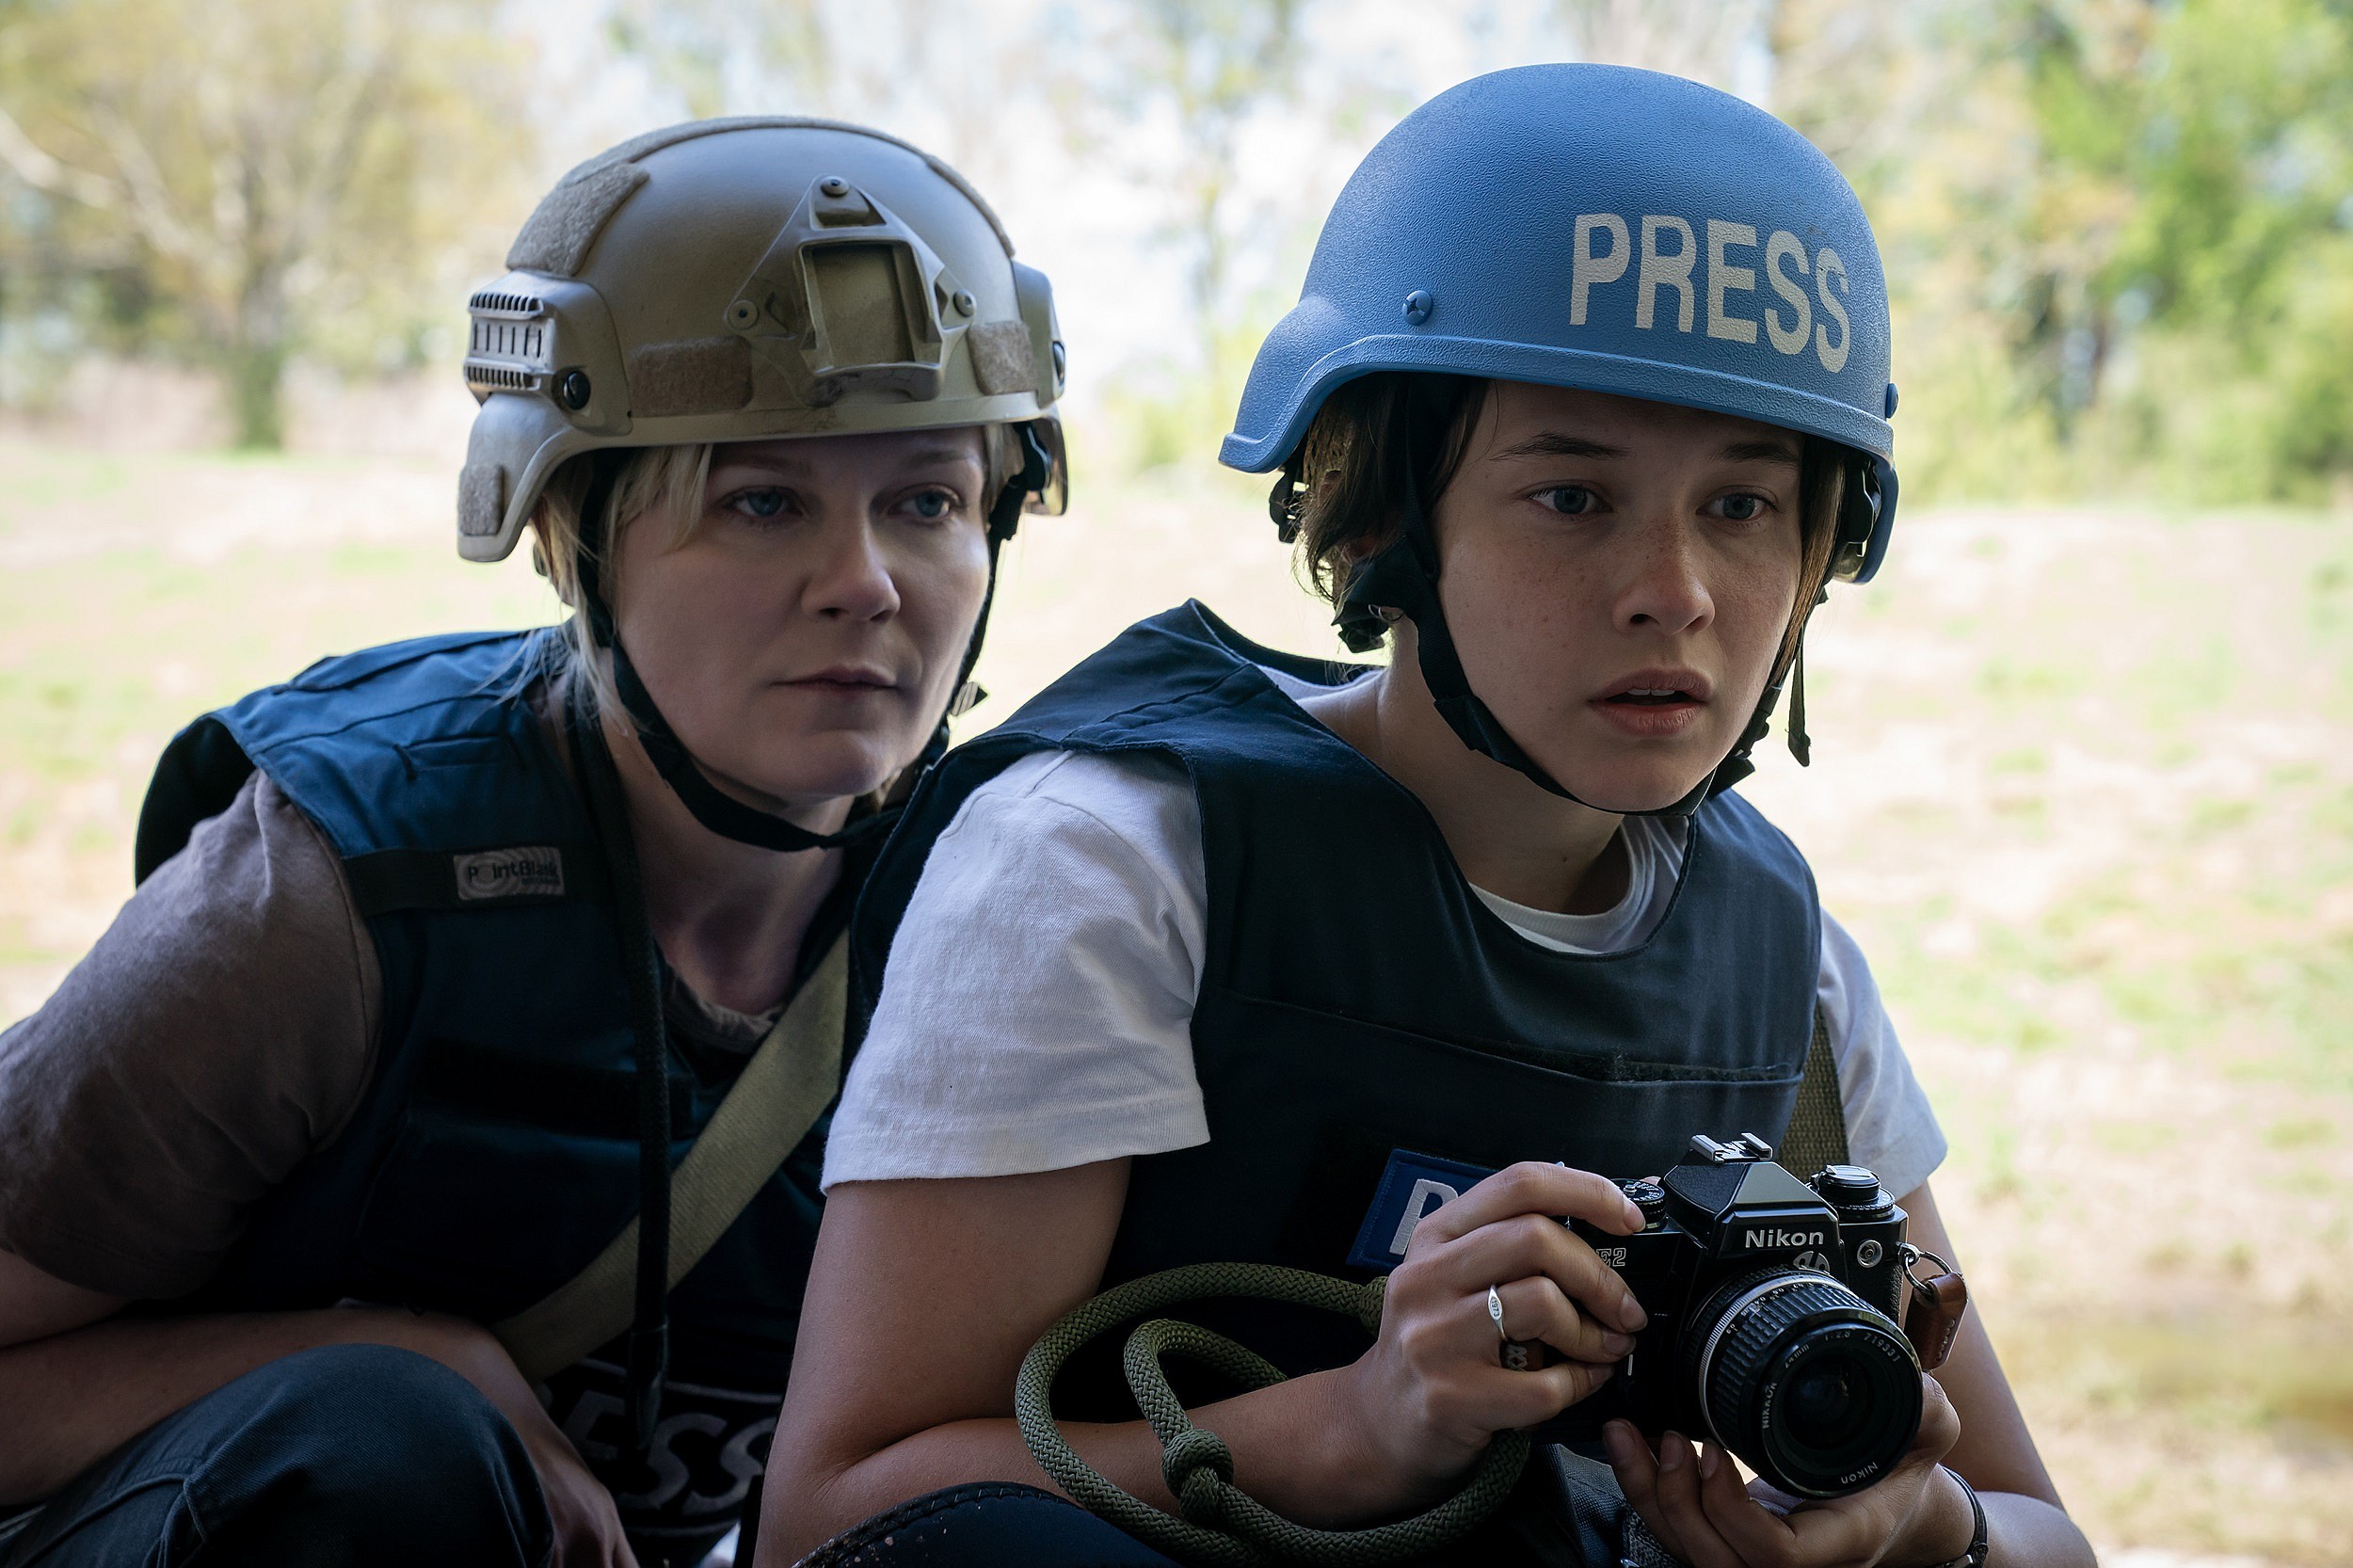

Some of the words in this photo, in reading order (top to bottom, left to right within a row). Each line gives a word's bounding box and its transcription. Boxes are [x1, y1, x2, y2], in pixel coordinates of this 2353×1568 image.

[1570, 213, 1850, 373] PRESS
[1745, 1228, 1824, 1248] Nikon
[1491, 1300, 1500, 1318] 1973
[1863, 1332, 1901, 1363] 719331
[1840, 1461, 1880, 1485] Nikon
